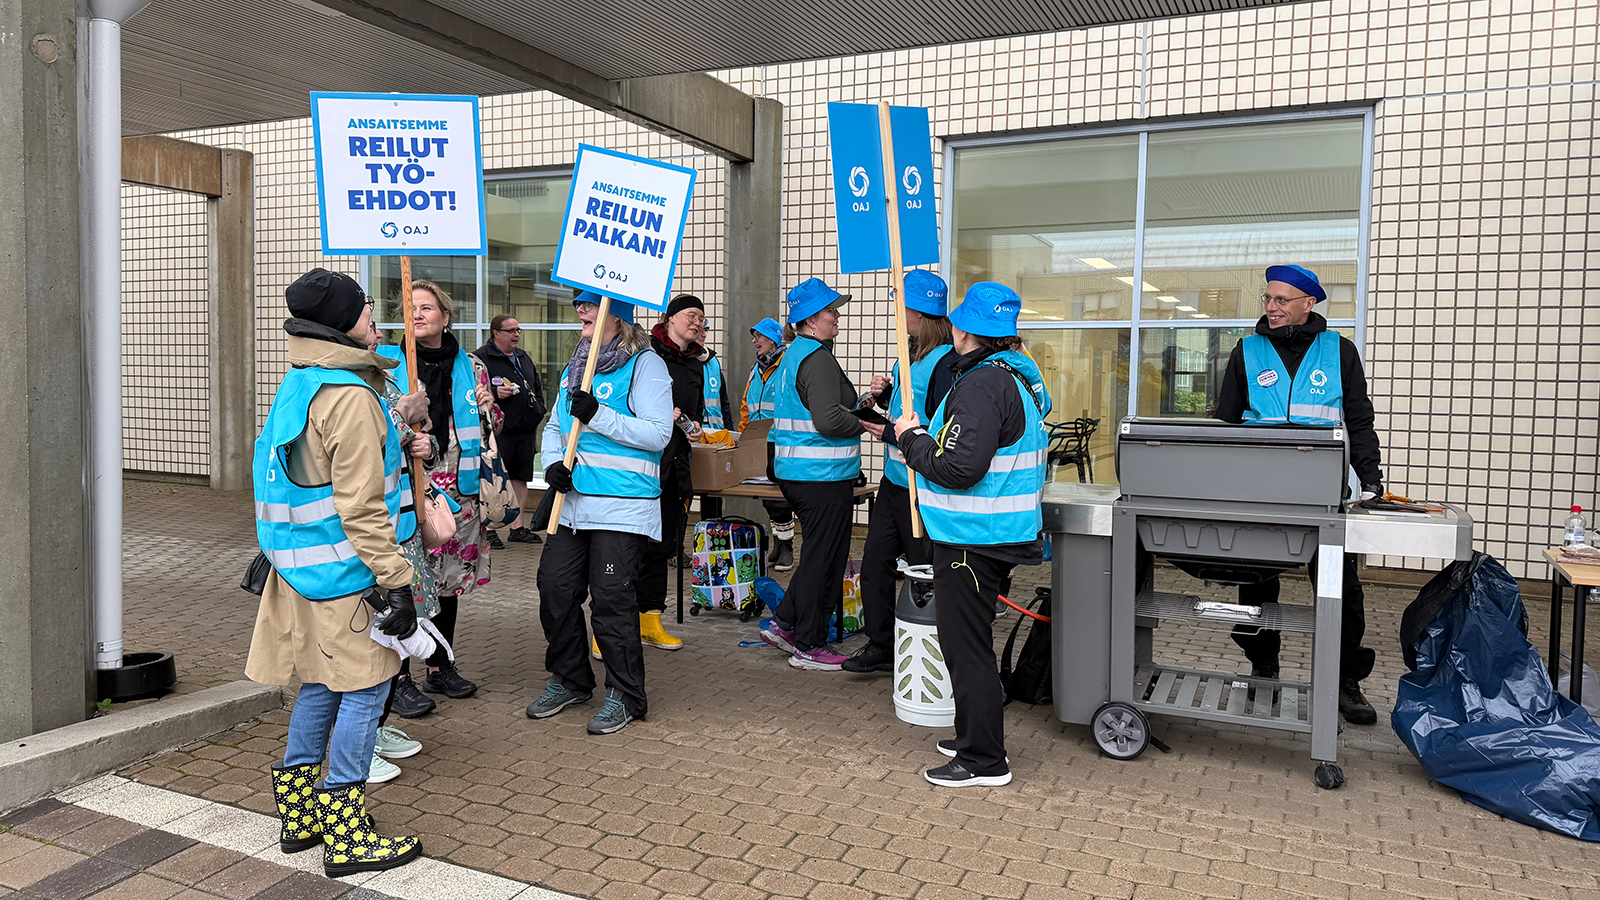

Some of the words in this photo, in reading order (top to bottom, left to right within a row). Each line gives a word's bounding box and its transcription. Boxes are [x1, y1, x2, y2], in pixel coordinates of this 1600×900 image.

[347, 118, 448, 130] ANSAITSEMME
[348, 136, 449, 158] REILUT
[365, 158, 435, 184] TYÖ-
[347, 190, 457, 211] EHDOT!
[591, 181, 667, 207] ANSAITSEMME
[906, 200, 922, 209] OAJ
[586, 196, 664, 233] REILUN
[852, 202, 870, 212] OAJ
[403, 225, 429, 235] OAJ
[572, 218, 667, 259] PALKAN!
[608, 271, 628, 282] OAJ
